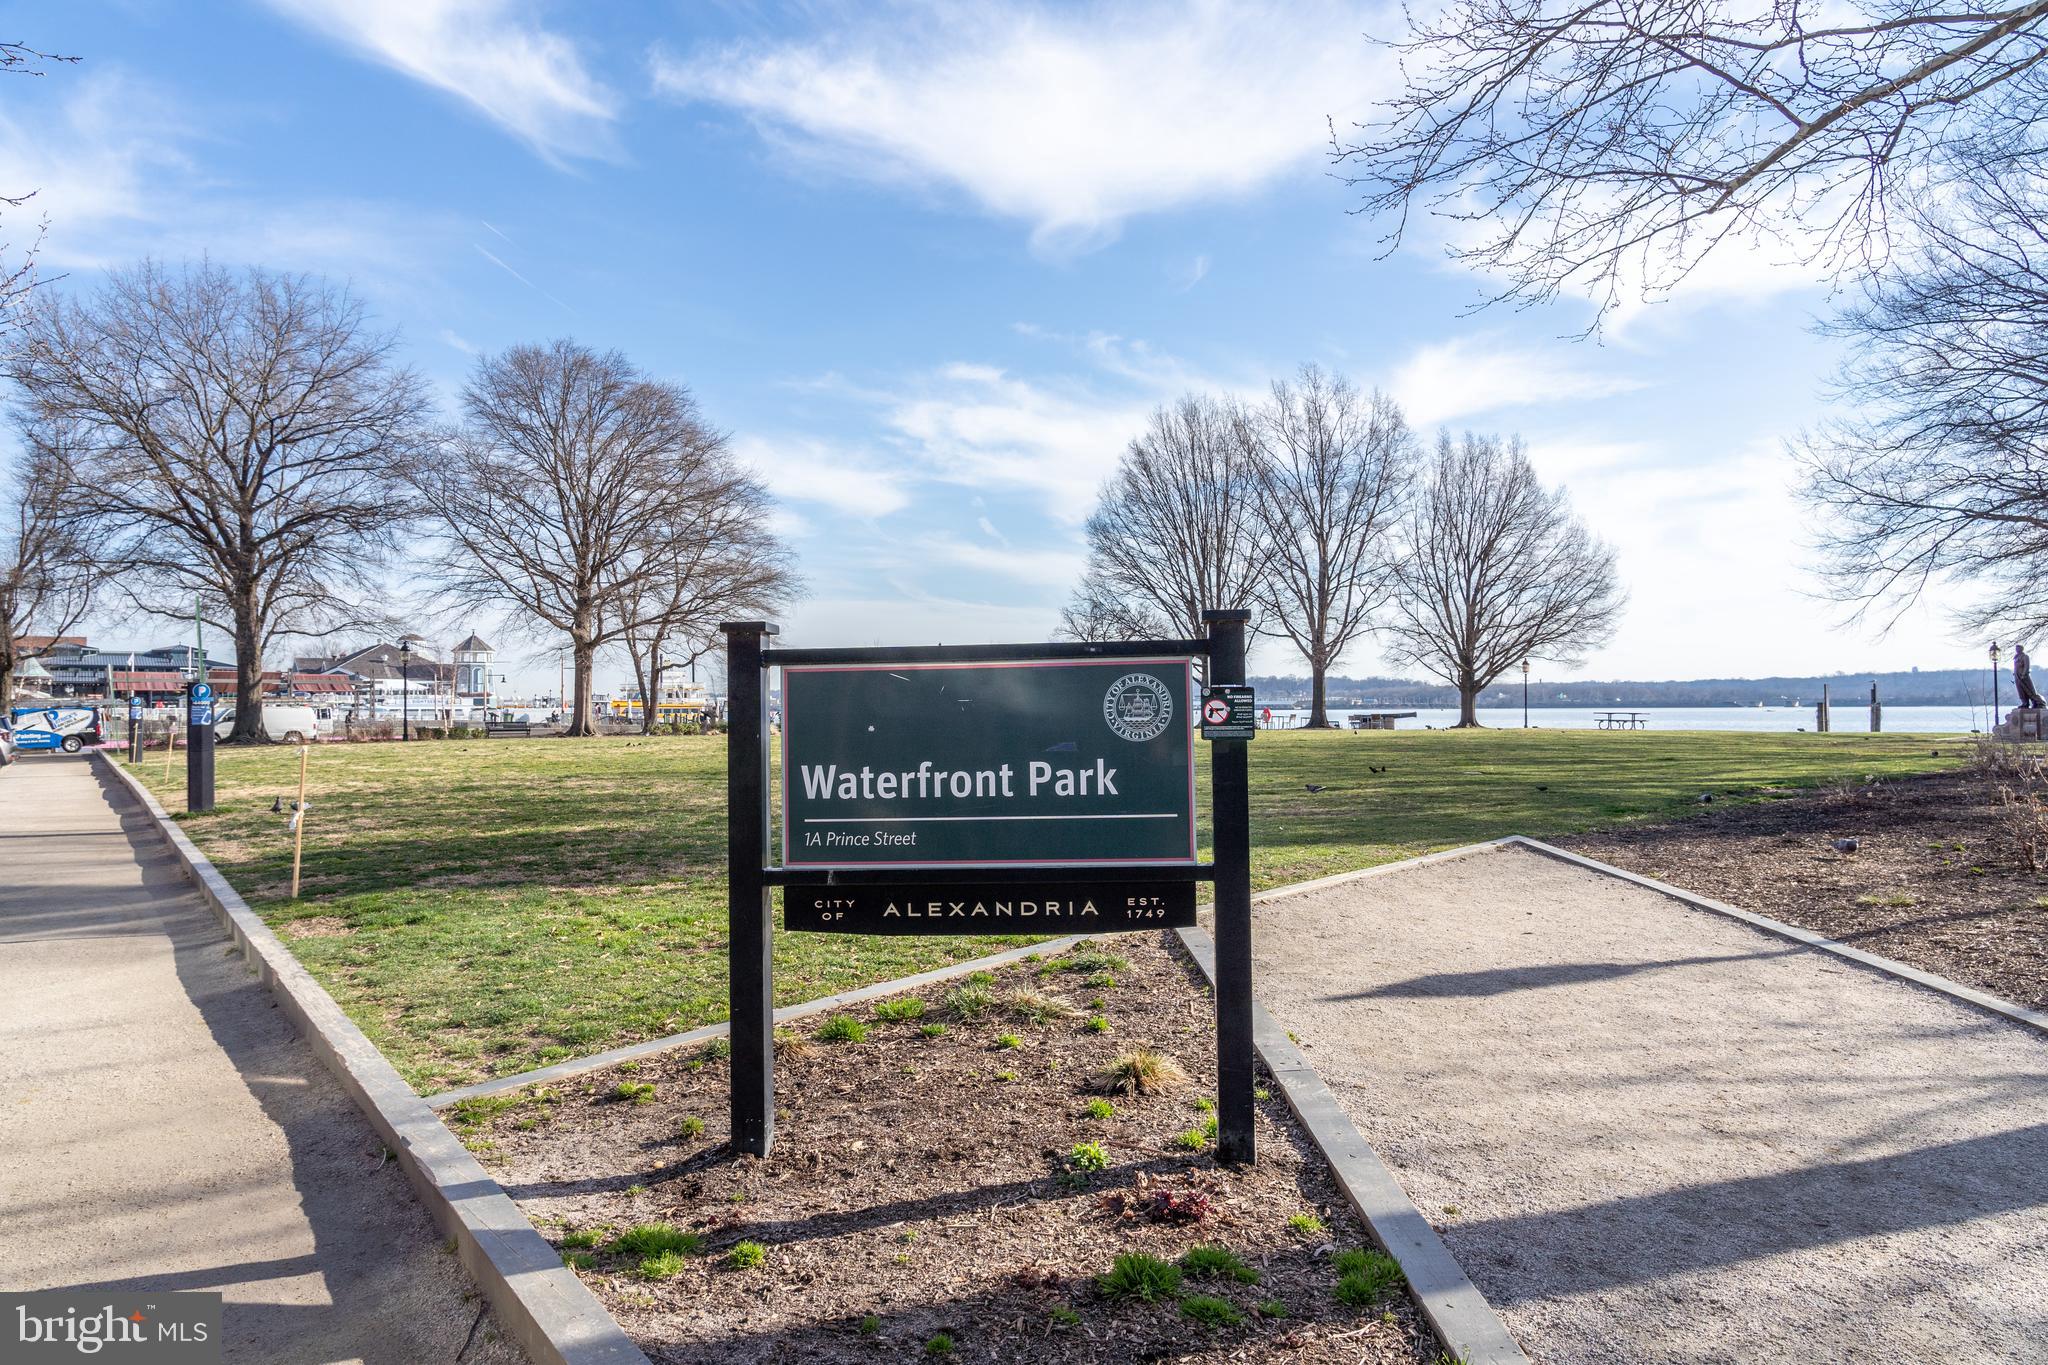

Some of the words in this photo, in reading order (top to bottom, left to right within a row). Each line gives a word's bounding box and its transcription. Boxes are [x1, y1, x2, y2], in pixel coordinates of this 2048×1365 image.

[1106, 697, 1115, 719] CITY
[1111, 681, 1125, 694] OF
[1125, 675, 1170, 719] ALEXANDRIA
[1113, 722, 1164, 739] VIRGINIA
[800, 762, 1014, 800] Waterfront
[1029, 758, 1119, 797] Park
[804, 831, 822, 847] 1A
[826, 831, 870, 847] Prince
[873, 831, 917, 846] Street
[813, 900, 856, 909] CITY
[883, 901, 1099, 917] ALEXANDRIA
[1127, 897, 1166, 906] EST.
[821, 912, 844, 921] OF
[1126, 909, 1165, 919] 1749
